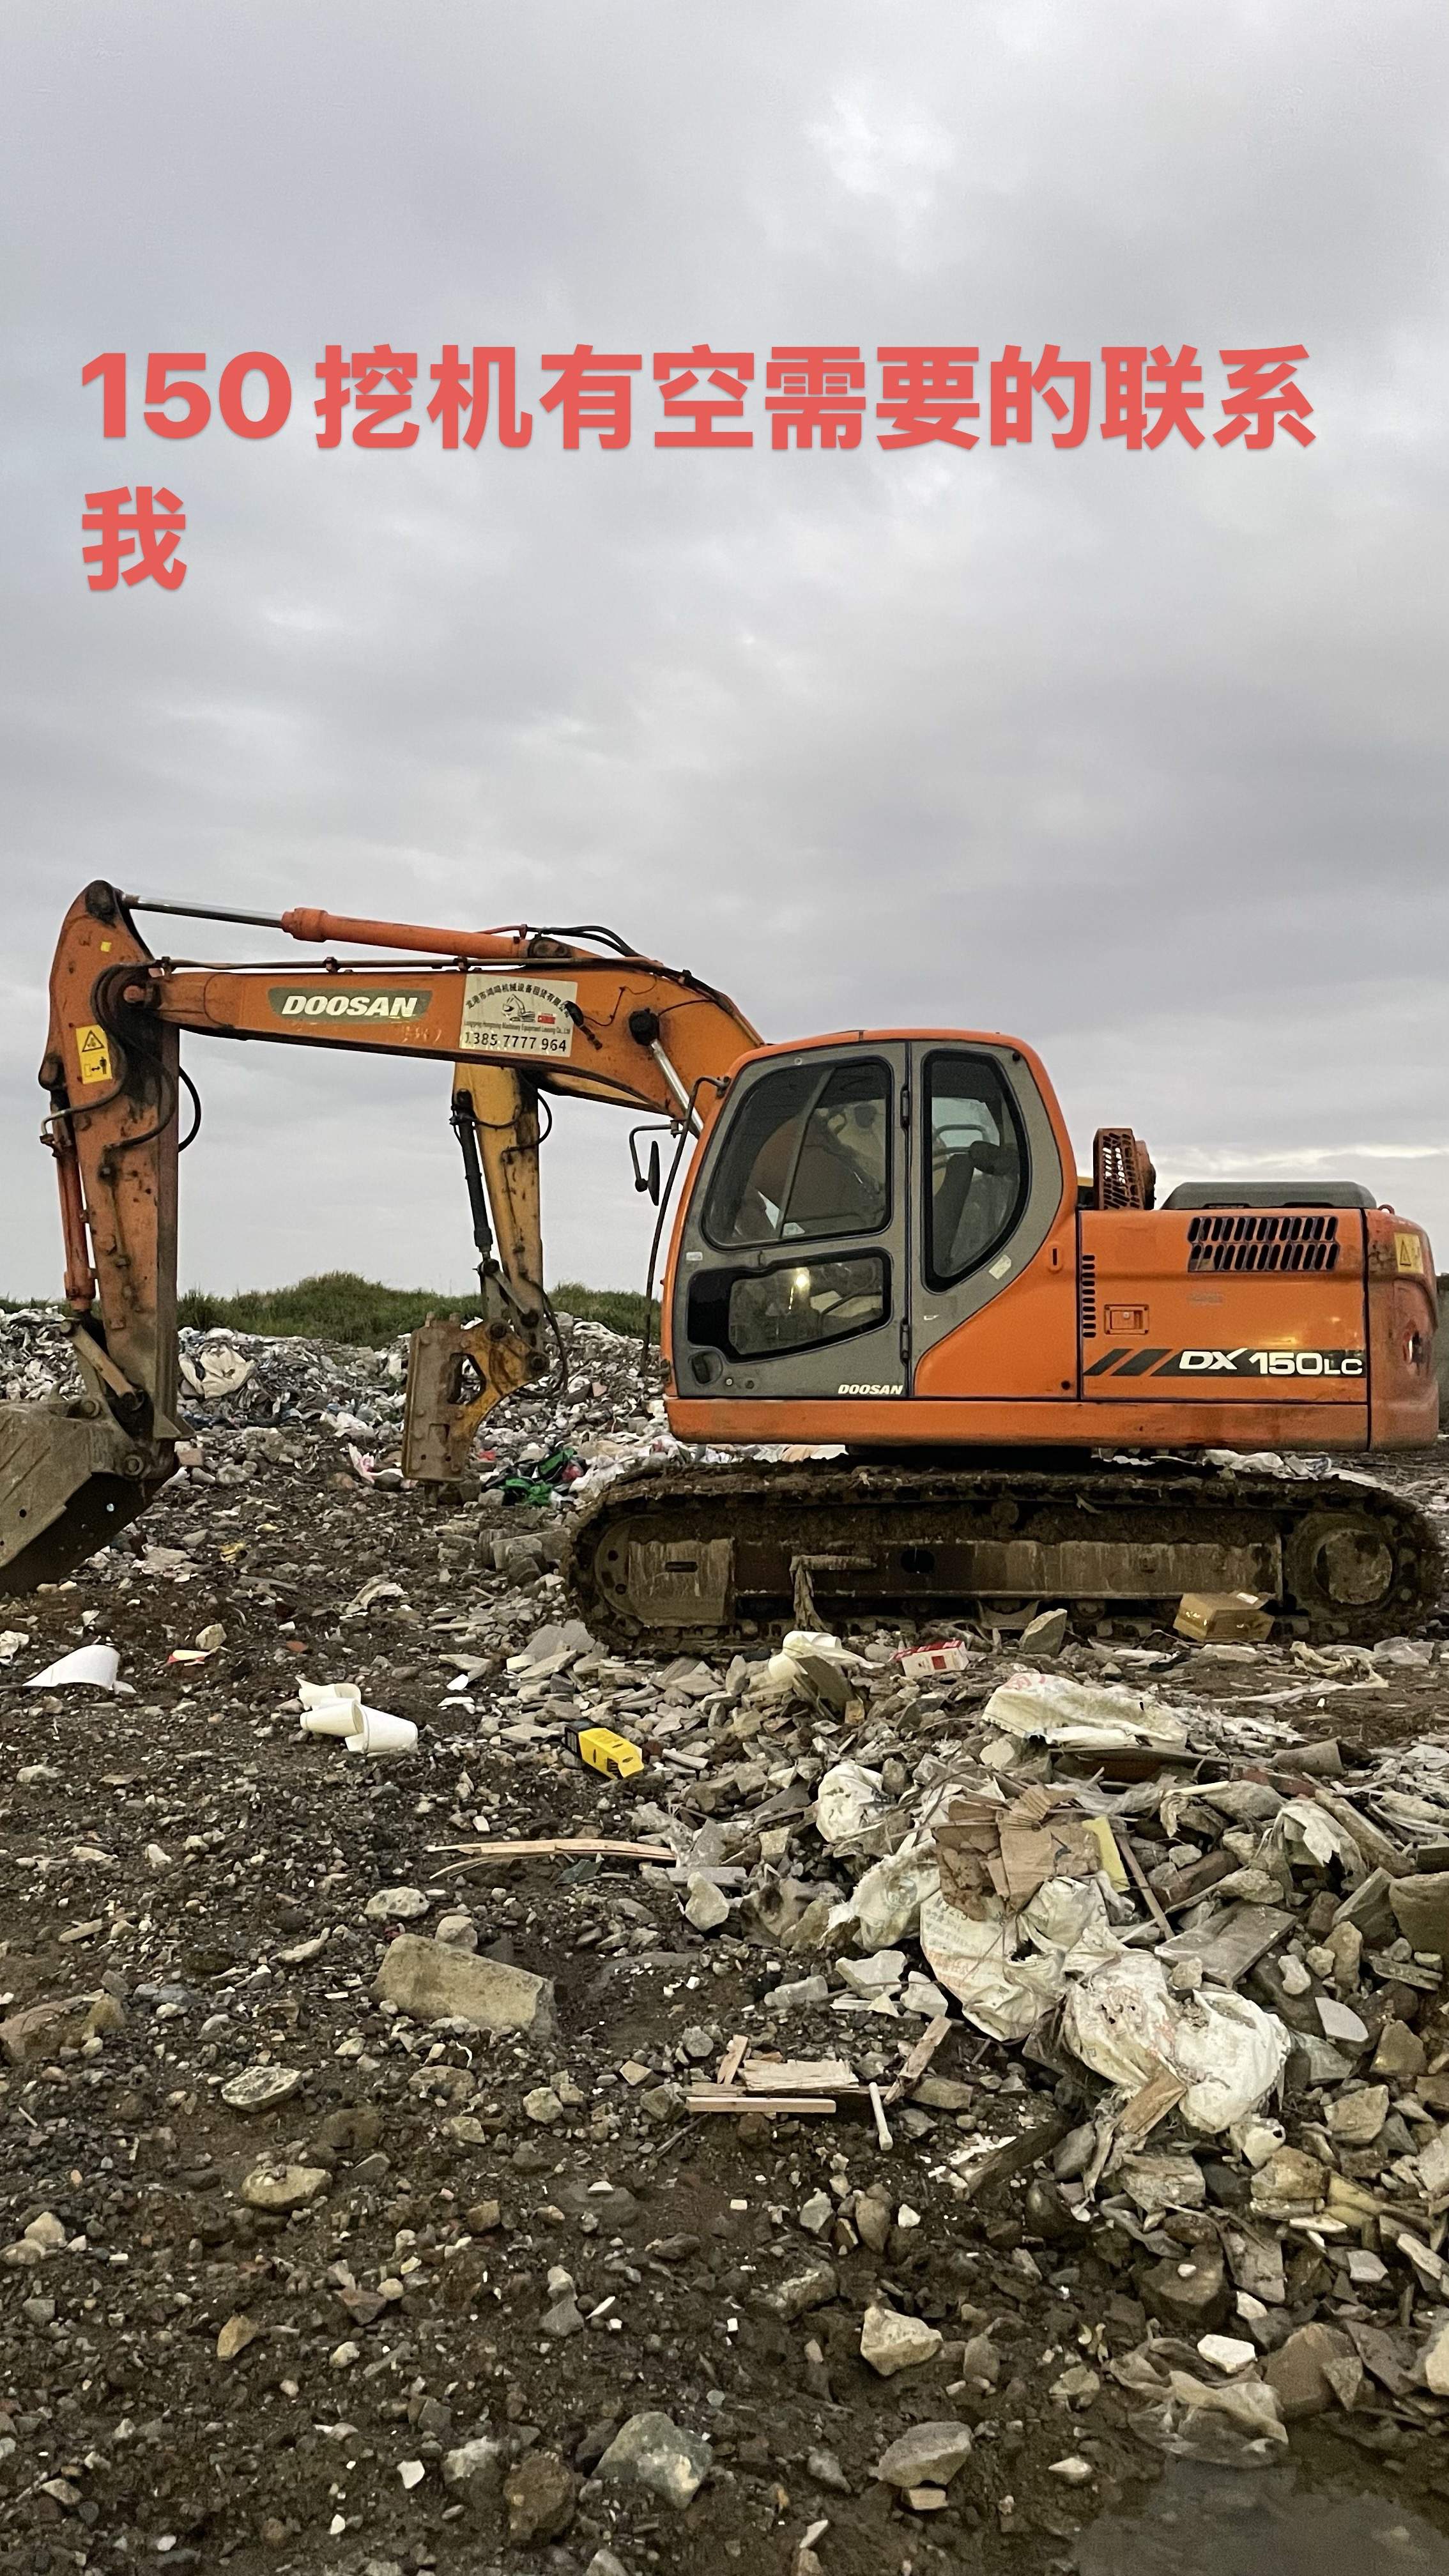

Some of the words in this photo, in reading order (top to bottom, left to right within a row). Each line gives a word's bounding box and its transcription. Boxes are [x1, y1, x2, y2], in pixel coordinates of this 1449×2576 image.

[282, 995, 418, 1017] DOOSAN
[541, 1038, 567, 1052] 964
[1179, 1347, 1248, 1370] DX
[838, 1384, 904, 1395] DOOSAN
